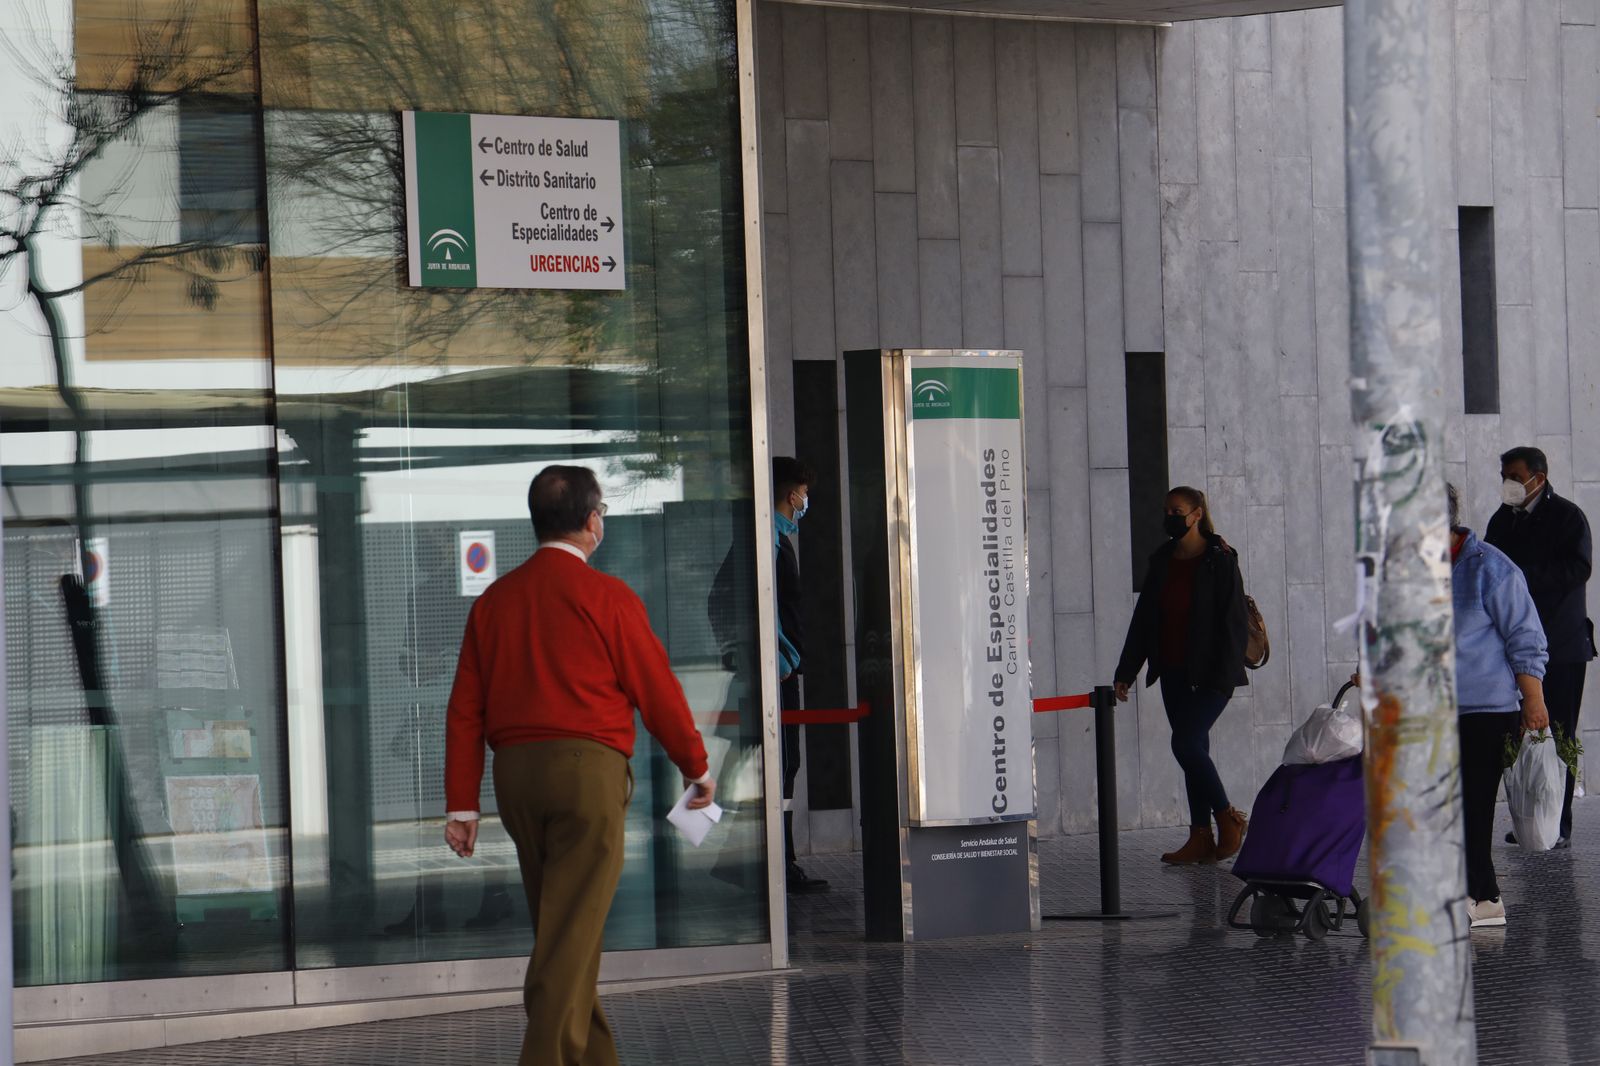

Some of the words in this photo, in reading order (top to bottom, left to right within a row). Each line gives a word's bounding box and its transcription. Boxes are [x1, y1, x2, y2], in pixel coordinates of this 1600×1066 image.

[494, 136, 535, 157] Centro
[538, 139, 552, 157] de
[556, 140, 588, 158] Salud
[497, 169, 540, 188] Distrito
[543, 171, 597, 190] Sanitario
[540, 202, 580, 221] Centro
[583, 204, 598, 221] de
[512, 222, 599, 244] Especialidades
[530, 254, 600, 273] URGENCIAS
[1000, 449, 1011, 491] Pino
[1001, 500, 1012, 528] del
[980, 448, 1005, 662] Especialidades
[1002, 535, 1016, 607] Castilla
[1006, 613, 1018, 675] Carlos
[988, 672, 1004, 707] de
[992, 715, 1008, 815] Centro
[957, 851, 963, 859] DE
[963, 850, 977, 859] SALUD
[980, 849, 1002, 858] BIENESTAR
[1002, 848, 1018, 856] SOCIAL
[960, 839, 978, 848] Servicio
[978, 838, 998, 846] Andaluz
[998, 837, 1004, 845] de
[1004, 836, 1018, 844] Salud
